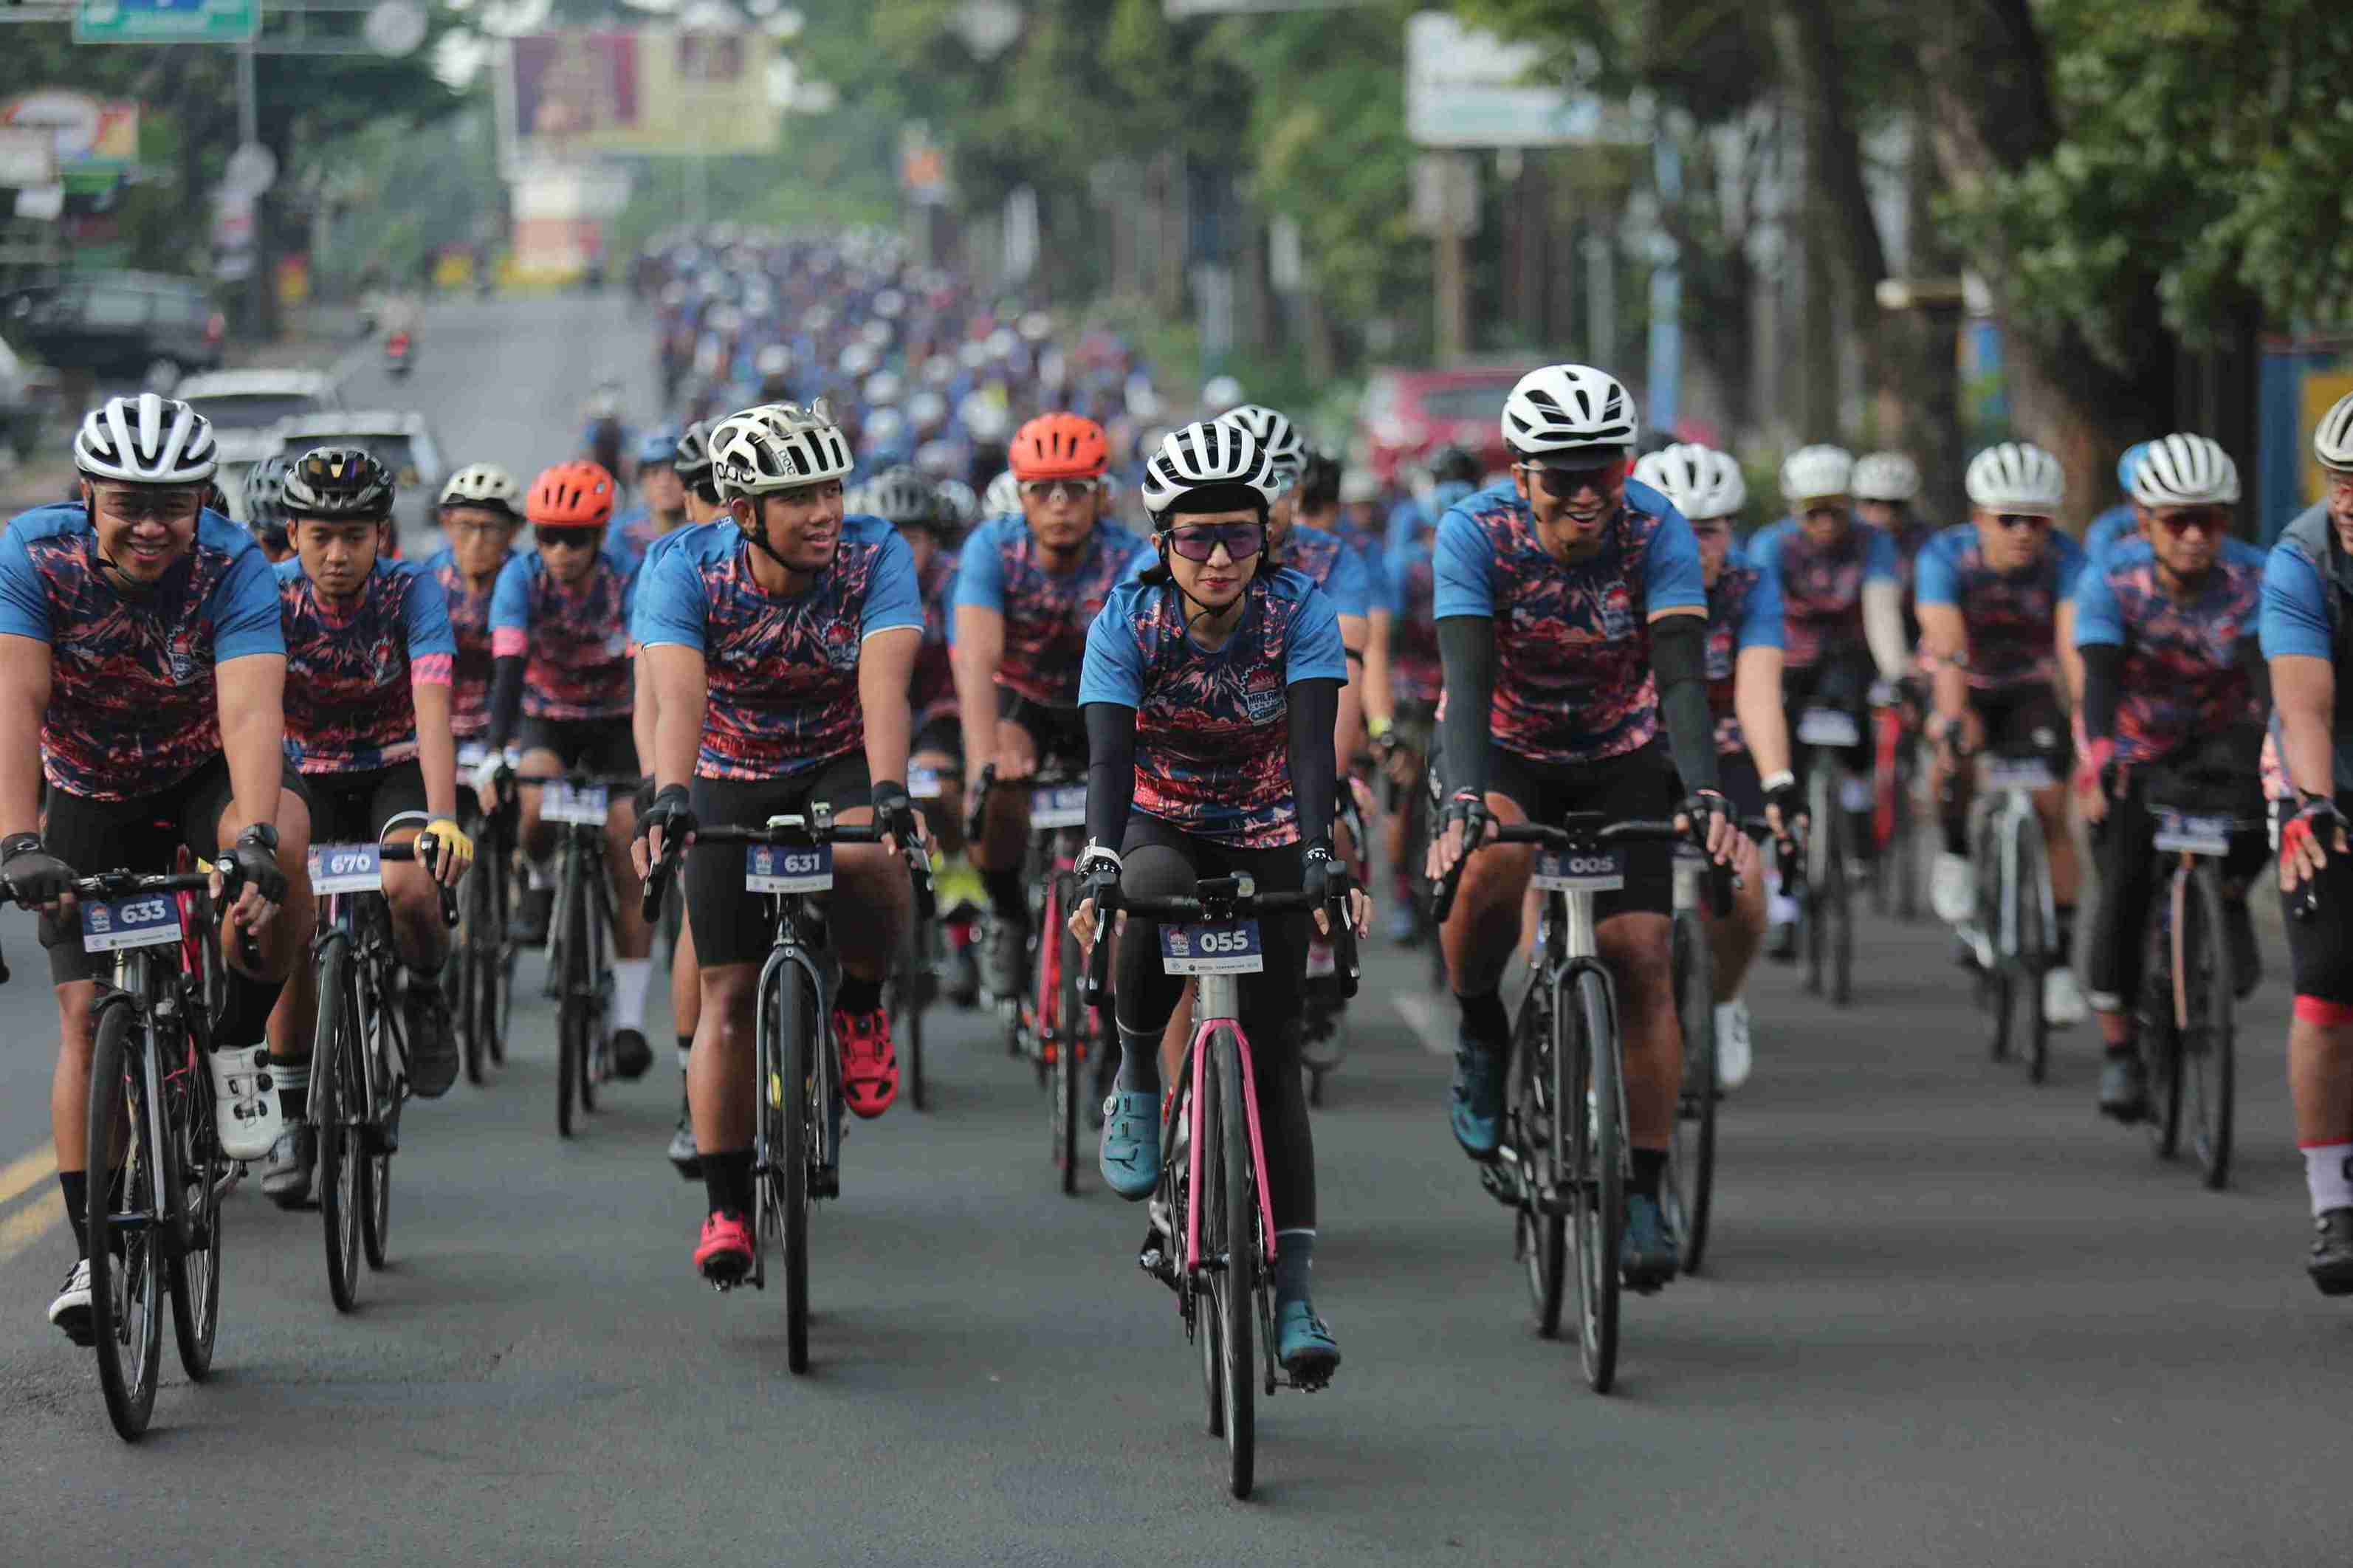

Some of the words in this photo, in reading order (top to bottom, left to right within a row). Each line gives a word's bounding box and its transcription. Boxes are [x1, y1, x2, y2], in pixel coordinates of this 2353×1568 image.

[331, 853, 371, 874] 670
[785, 853, 820, 873] 631
[120, 900, 166, 924] 633
[1200, 930, 1248, 952] 055
